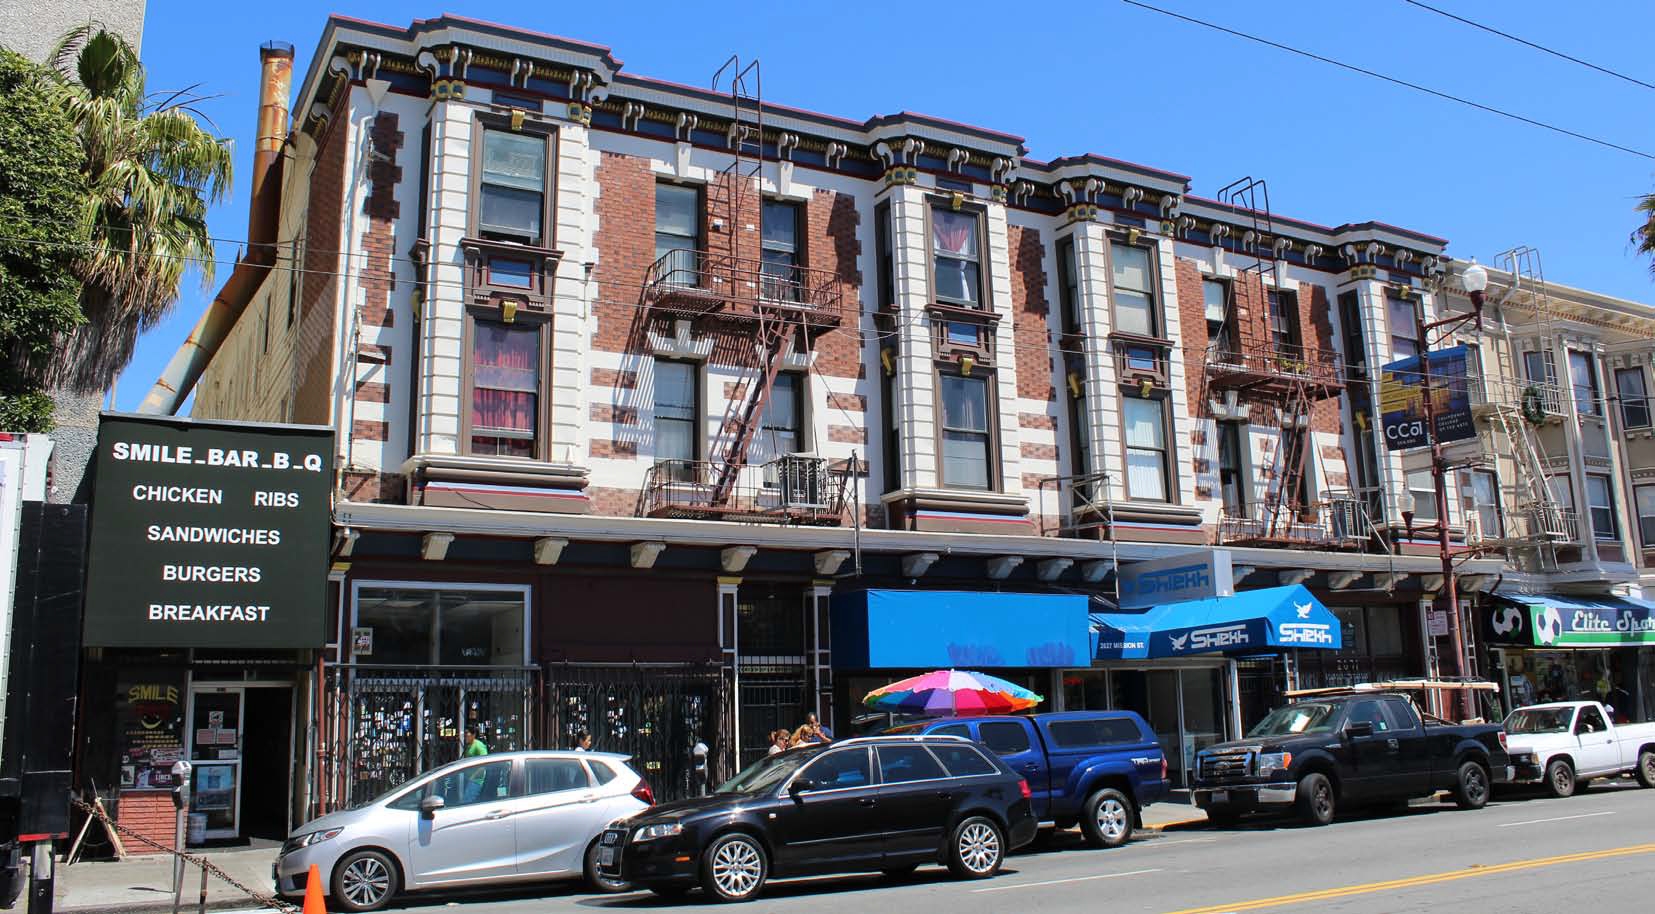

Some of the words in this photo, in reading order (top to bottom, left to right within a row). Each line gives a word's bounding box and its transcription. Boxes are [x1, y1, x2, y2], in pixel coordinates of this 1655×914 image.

[133, 485, 223, 505] CHICKEN
[255, 491, 299, 508] RIBS
[148, 525, 281, 545] SANDWICHES
[163, 565, 261, 583] BURGERS
[149, 604, 271, 622] BREAKFAST
[1571, 609, 1612, 632] Elite
[128, 684, 179, 705] SMILE
